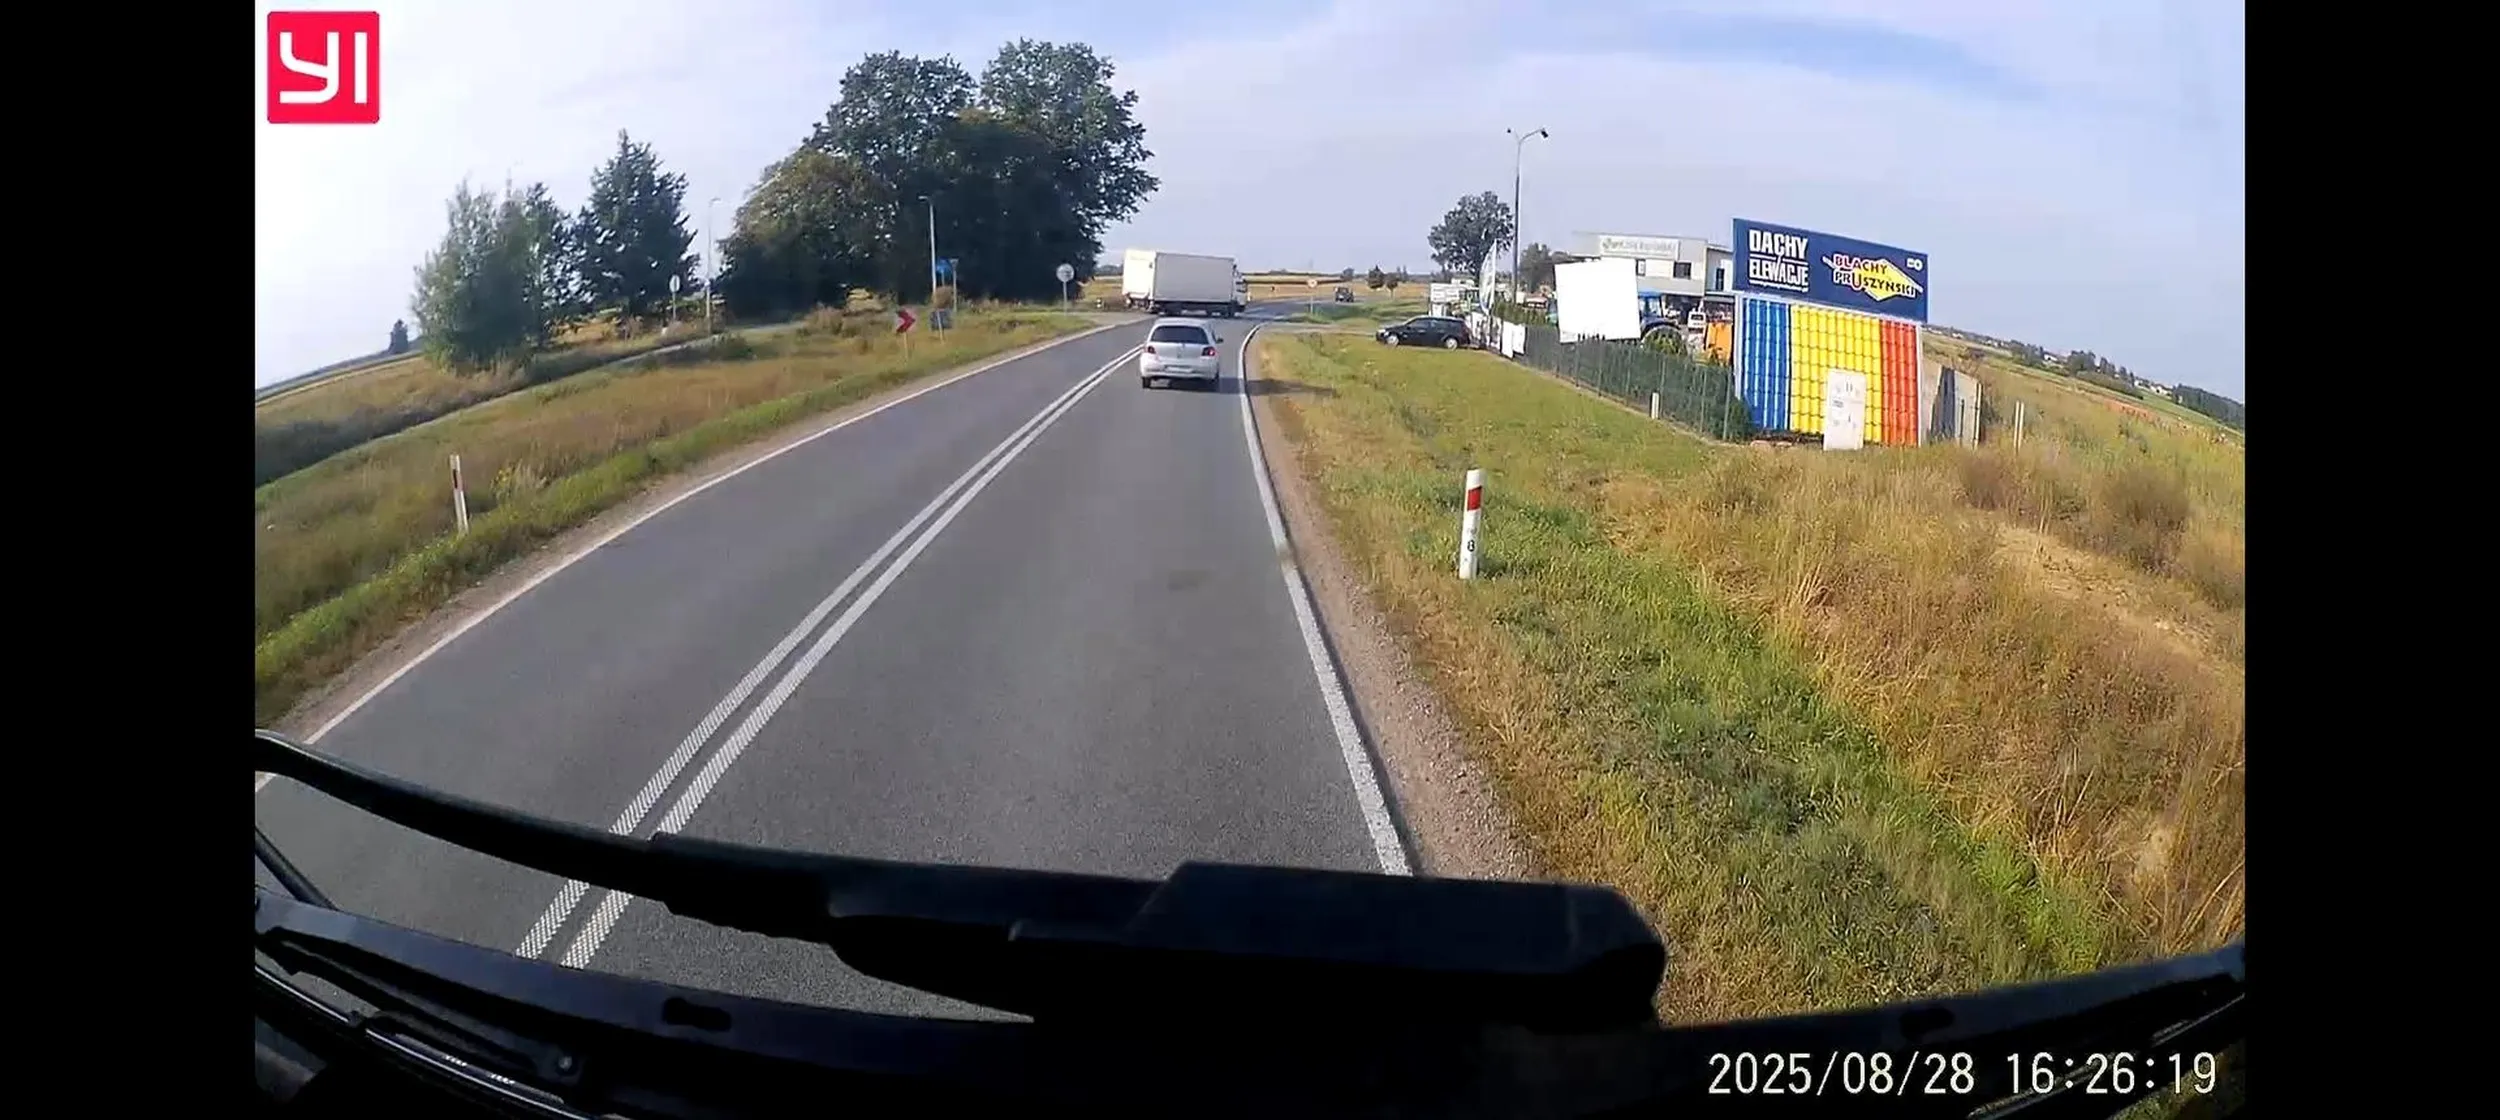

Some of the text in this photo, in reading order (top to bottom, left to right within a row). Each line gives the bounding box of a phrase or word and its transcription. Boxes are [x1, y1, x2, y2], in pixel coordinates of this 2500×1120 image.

[1749, 229, 1808, 260] DACHY
[1749, 258, 1809, 286] ELEWACJE
[1835, 255, 1888, 275] BLACHY
